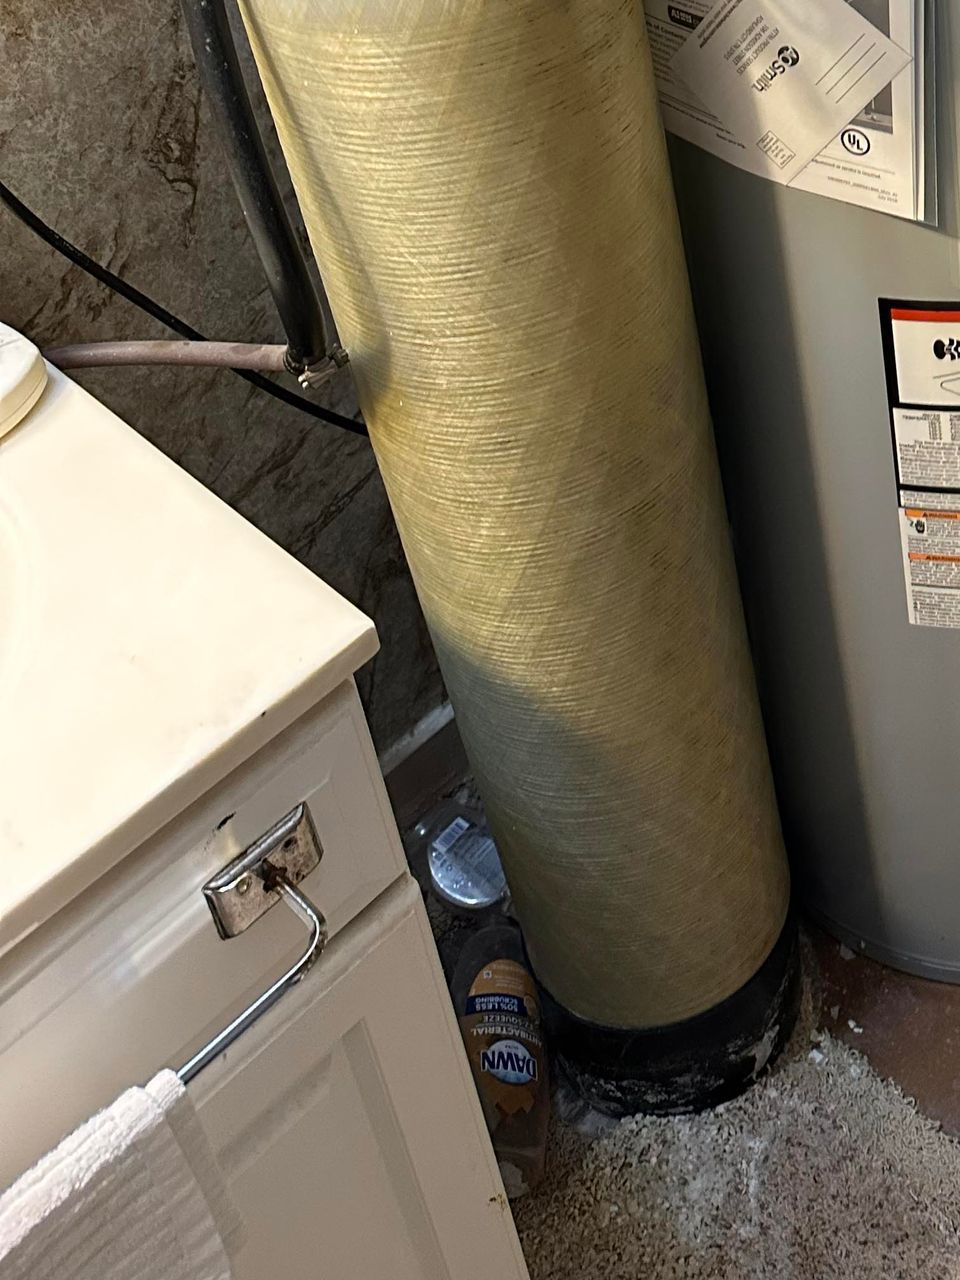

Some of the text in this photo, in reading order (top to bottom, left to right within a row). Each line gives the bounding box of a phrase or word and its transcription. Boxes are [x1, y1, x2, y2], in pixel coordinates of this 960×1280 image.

[475, 1003, 498, 1012] LESS
[471, 1026, 542, 1048] ANTIBACTERIAL
[481, 1050, 538, 1081] DAWN
